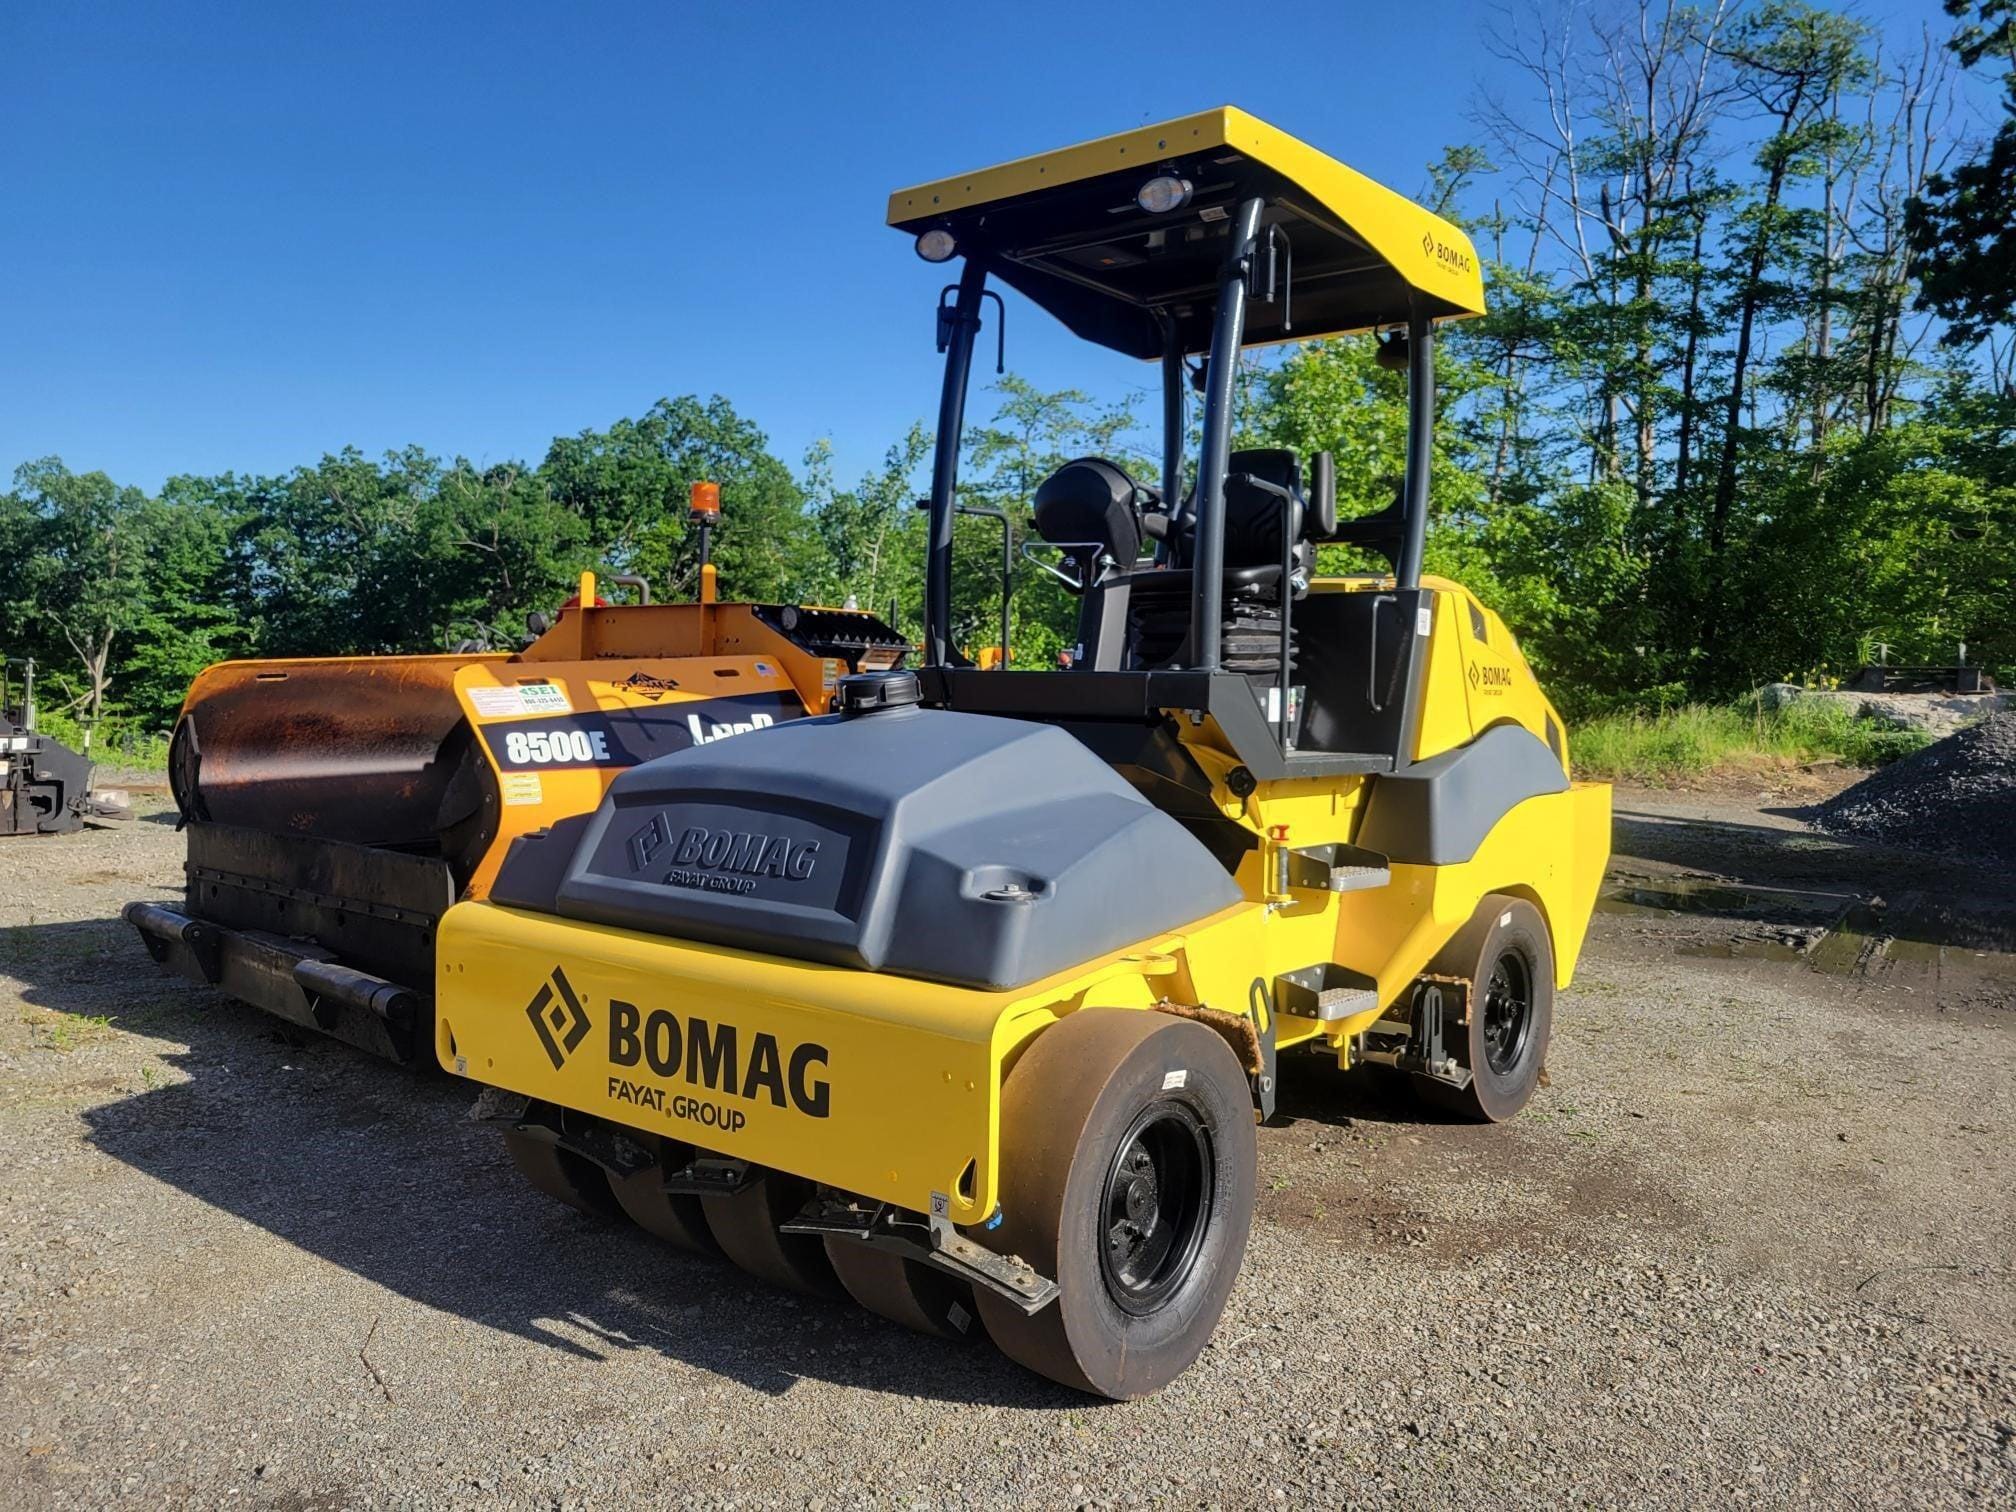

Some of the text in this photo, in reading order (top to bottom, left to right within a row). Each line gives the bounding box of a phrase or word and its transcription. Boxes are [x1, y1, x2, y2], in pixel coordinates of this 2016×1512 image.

[1437, 243, 1470, 272] BOMAG
[527, 686, 557, 696] SEI
[1482, 666, 1511, 686] BOMAG
[506, 731, 610, 764] 8500E
[674, 826, 821, 879] BOMAG
[668, 869, 756, 894] FAYAT GROUP
[608, 998, 830, 1119] BOMAG
[608, 1076, 746, 1133] FAYAT GROUP
